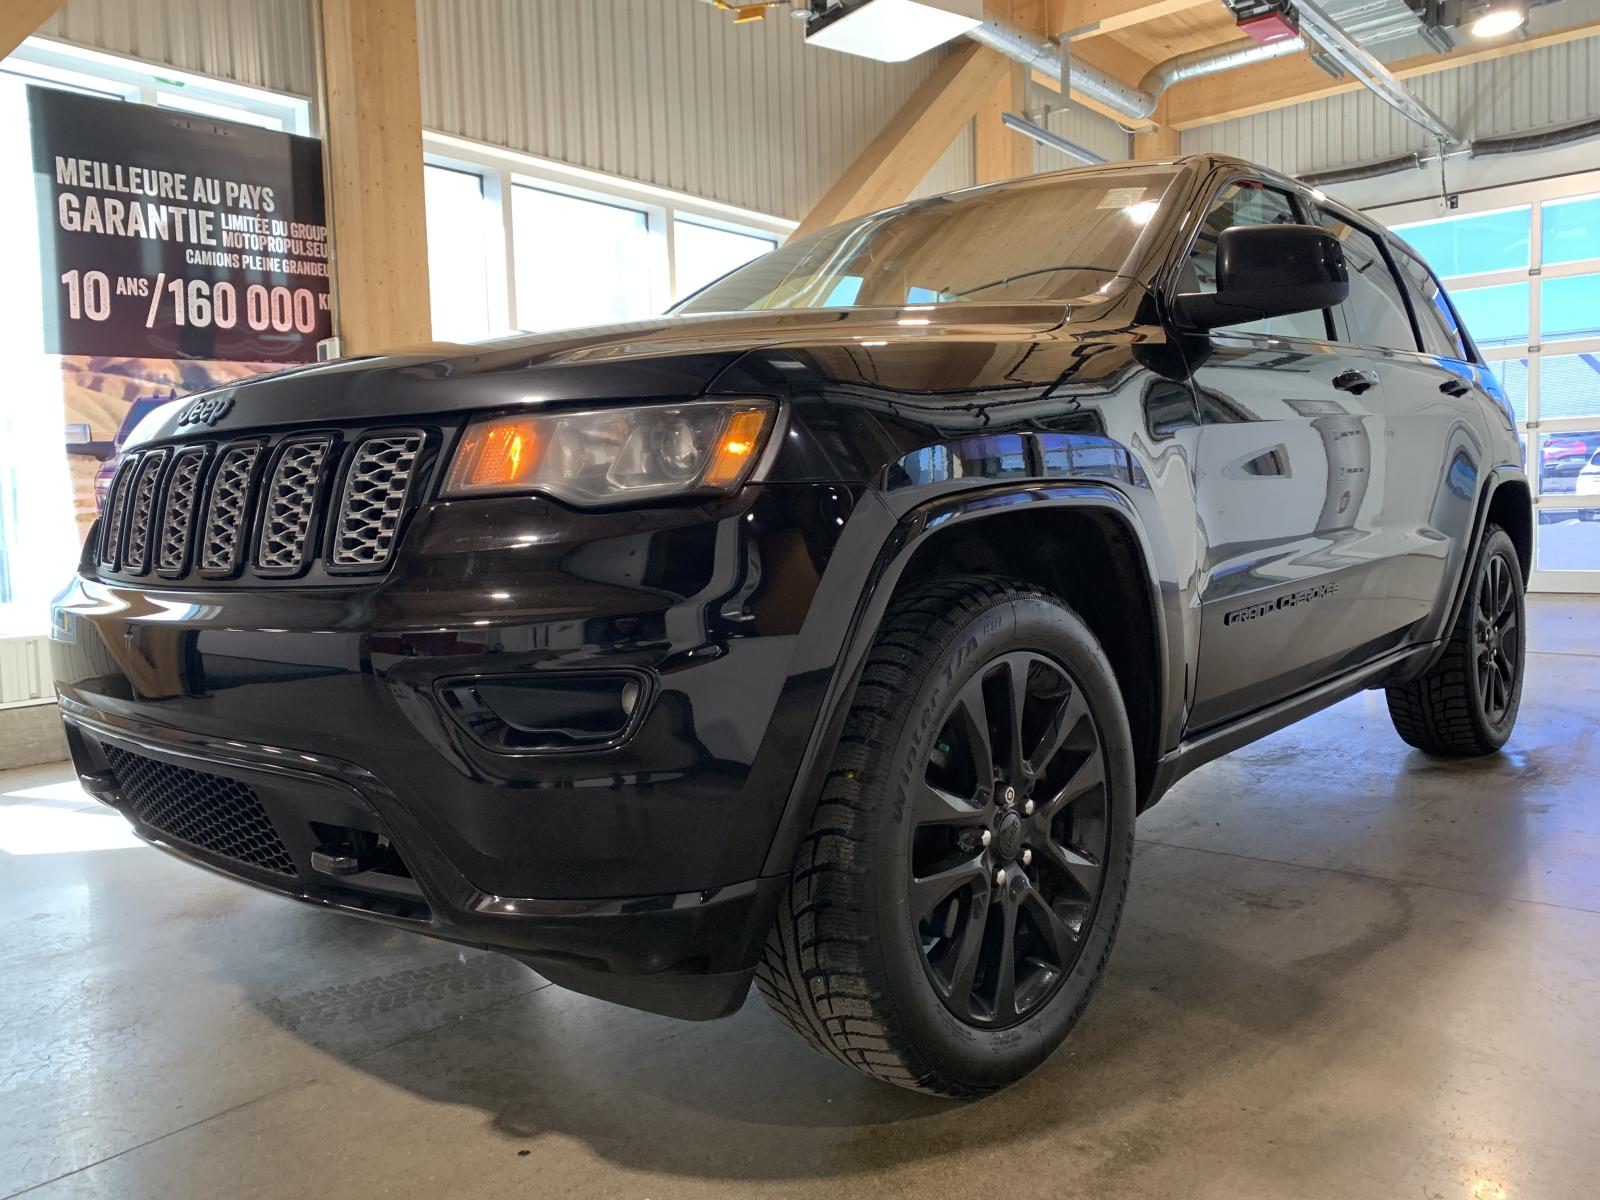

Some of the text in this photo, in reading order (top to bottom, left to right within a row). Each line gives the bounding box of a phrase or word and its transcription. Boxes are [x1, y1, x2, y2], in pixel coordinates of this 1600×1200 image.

[55, 155, 275, 213] MEILLEURE AU PAYS
[58, 192, 217, 247] GARANTIE
[221, 213, 270, 235] LIMITÉE
[272, 219, 288, 237] DU
[185, 249, 240, 270] CAMIONS
[242, 254, 281, 273] PLEINE
[61, 269, 111, 322] 10
[247, 284, 316, 334] 000
[318, 293, 331, 310] K
[177, 398, 236, 427] Jeep
